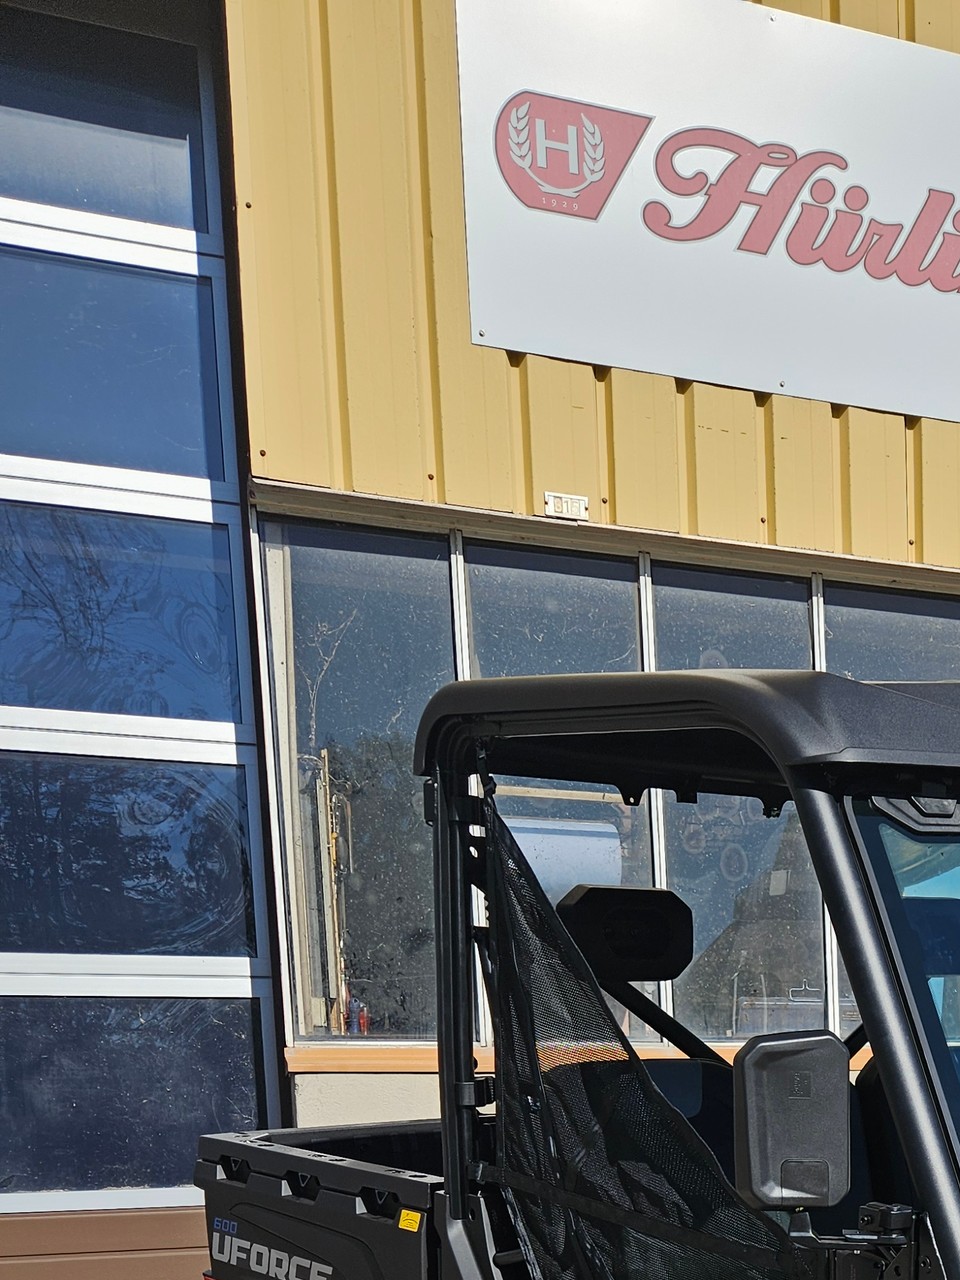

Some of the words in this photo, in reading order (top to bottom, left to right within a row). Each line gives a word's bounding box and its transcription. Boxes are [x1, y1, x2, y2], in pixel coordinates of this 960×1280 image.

[535, 118, 579, 175] H
[541, 197, 579, 211] 1929
[214, 1217, 238, 1234] 600
